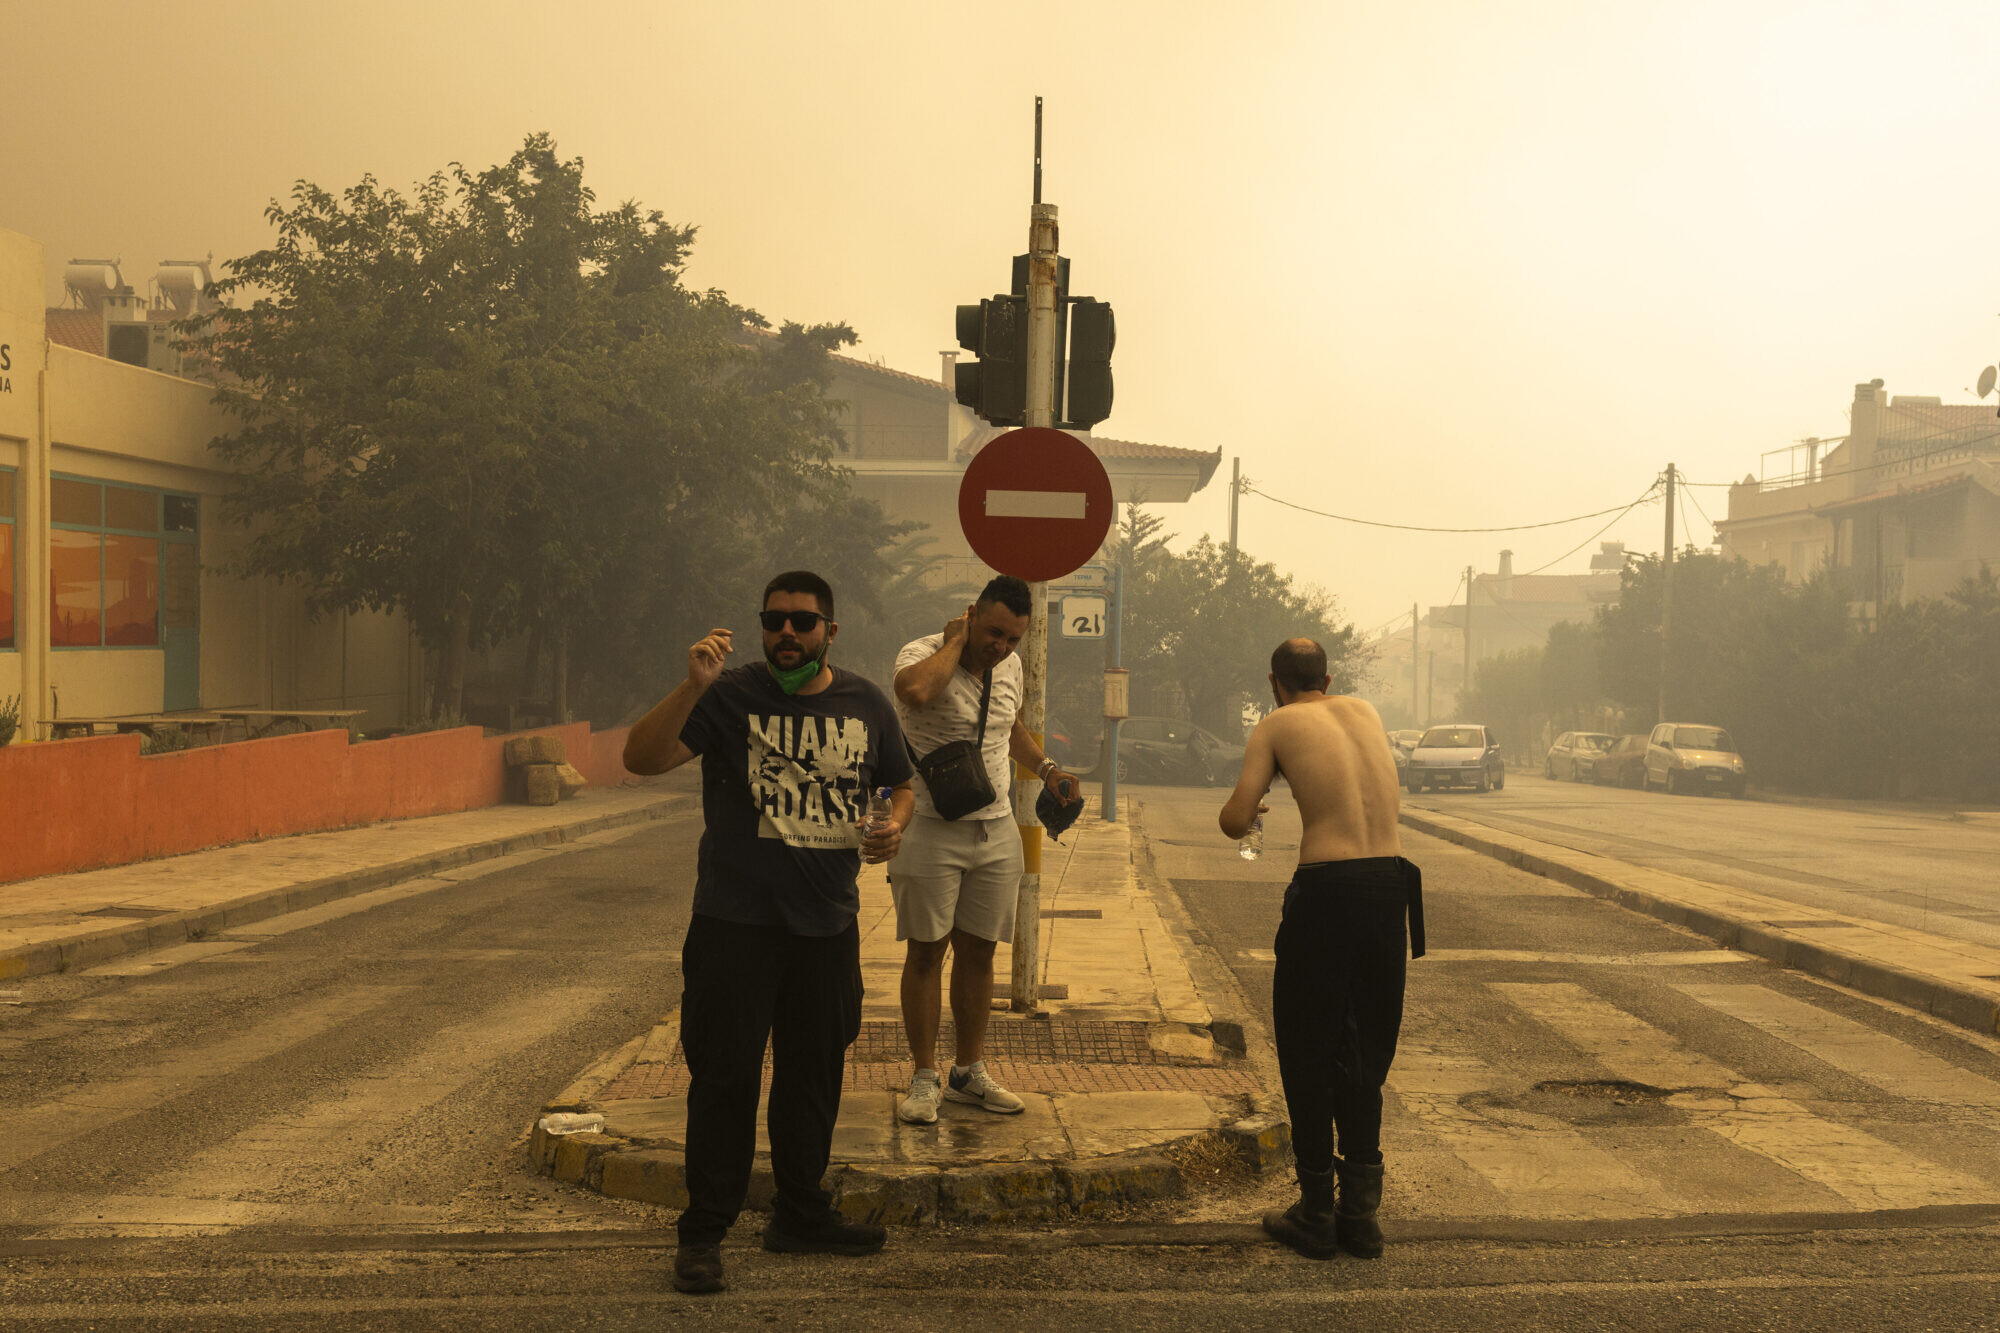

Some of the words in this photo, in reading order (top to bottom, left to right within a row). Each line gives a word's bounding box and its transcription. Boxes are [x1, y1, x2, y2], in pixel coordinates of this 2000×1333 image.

[0, 344, 11, 371] S
[1072, 614, 1100, 635] 21
[813, 835, 848, 844] PARADISE
